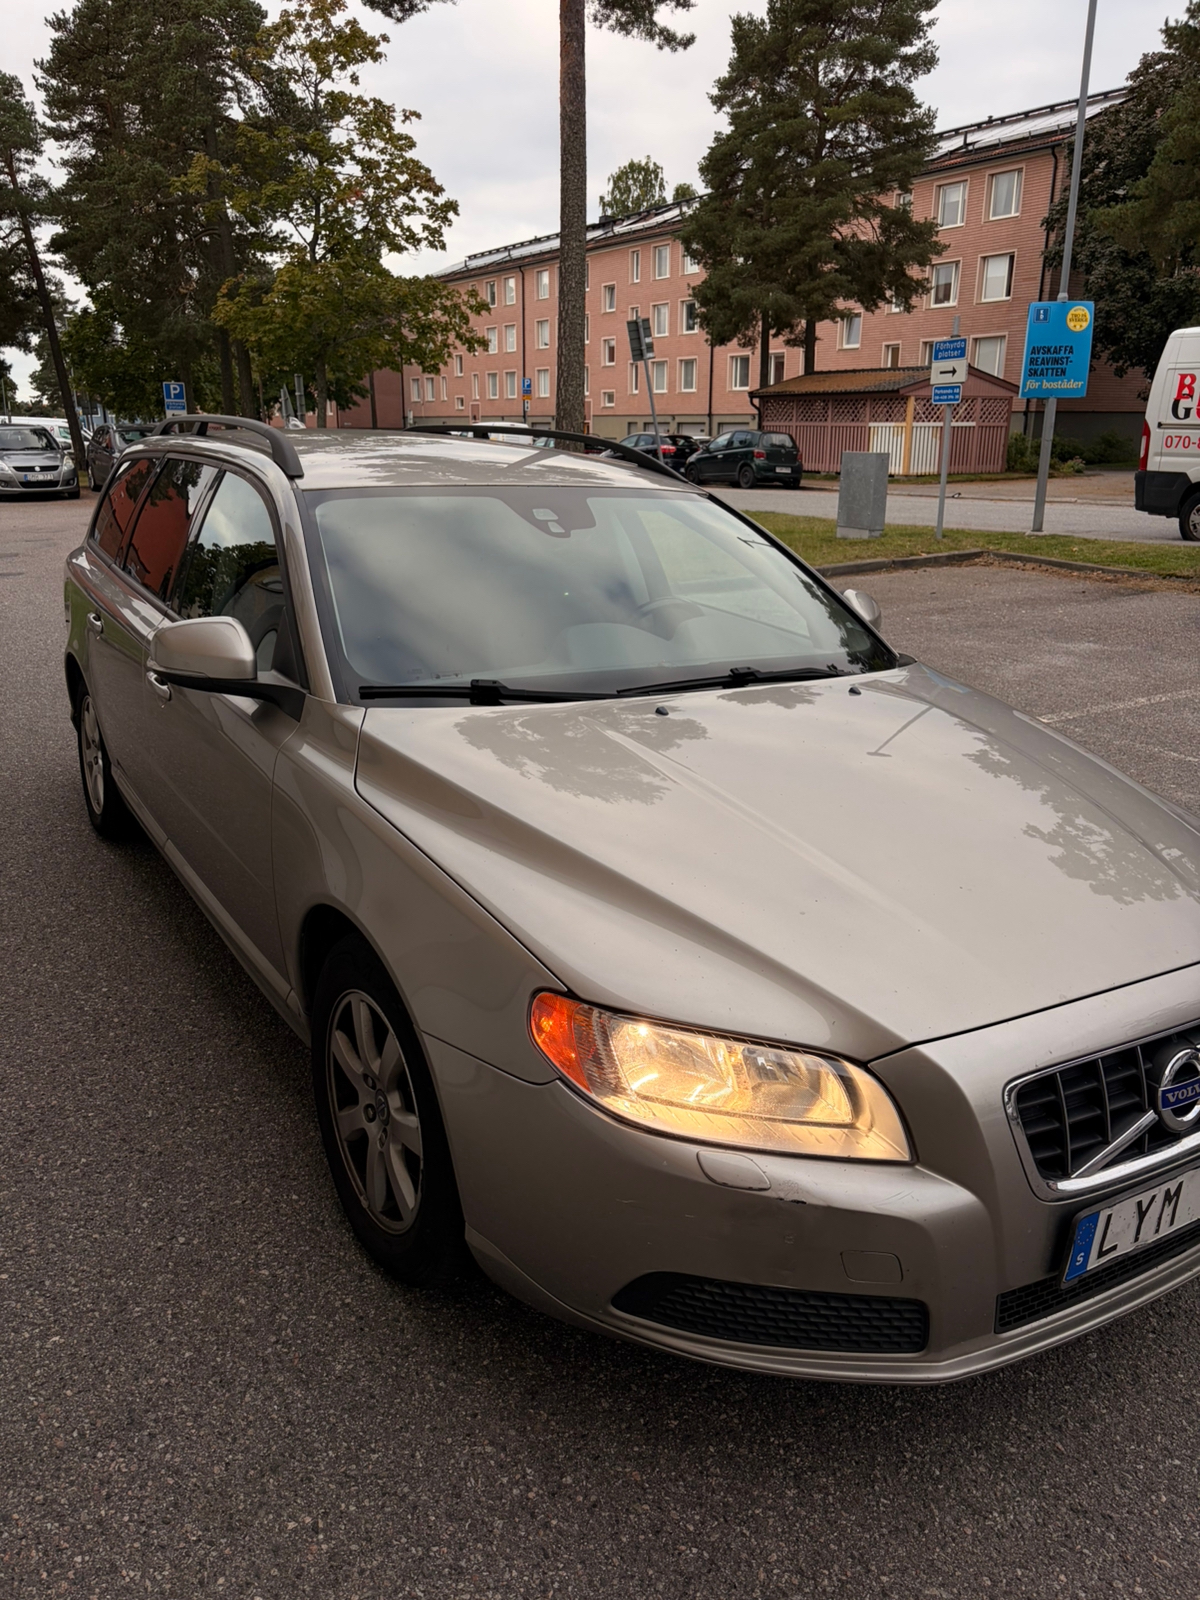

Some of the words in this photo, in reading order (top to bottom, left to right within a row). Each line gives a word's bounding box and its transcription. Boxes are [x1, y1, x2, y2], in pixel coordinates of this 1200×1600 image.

[936, 341, 965, 350] Förhyrda
[1030, 345, 1074, 355] AVSKAFFA
[938, 350, 961, 359] platser
[1029, 356, 1073, 366] REAVINST-
[1028, 367, 1067, 377] SKATTEN
[1024, 379, 1040, 392] för
[1042, 379, 1084, 389] bostäder
[170, 385, 180, 399] P
[1097, 1180, 1185, 1260] LYM
[1075, 1252, 1085, 1267] S
